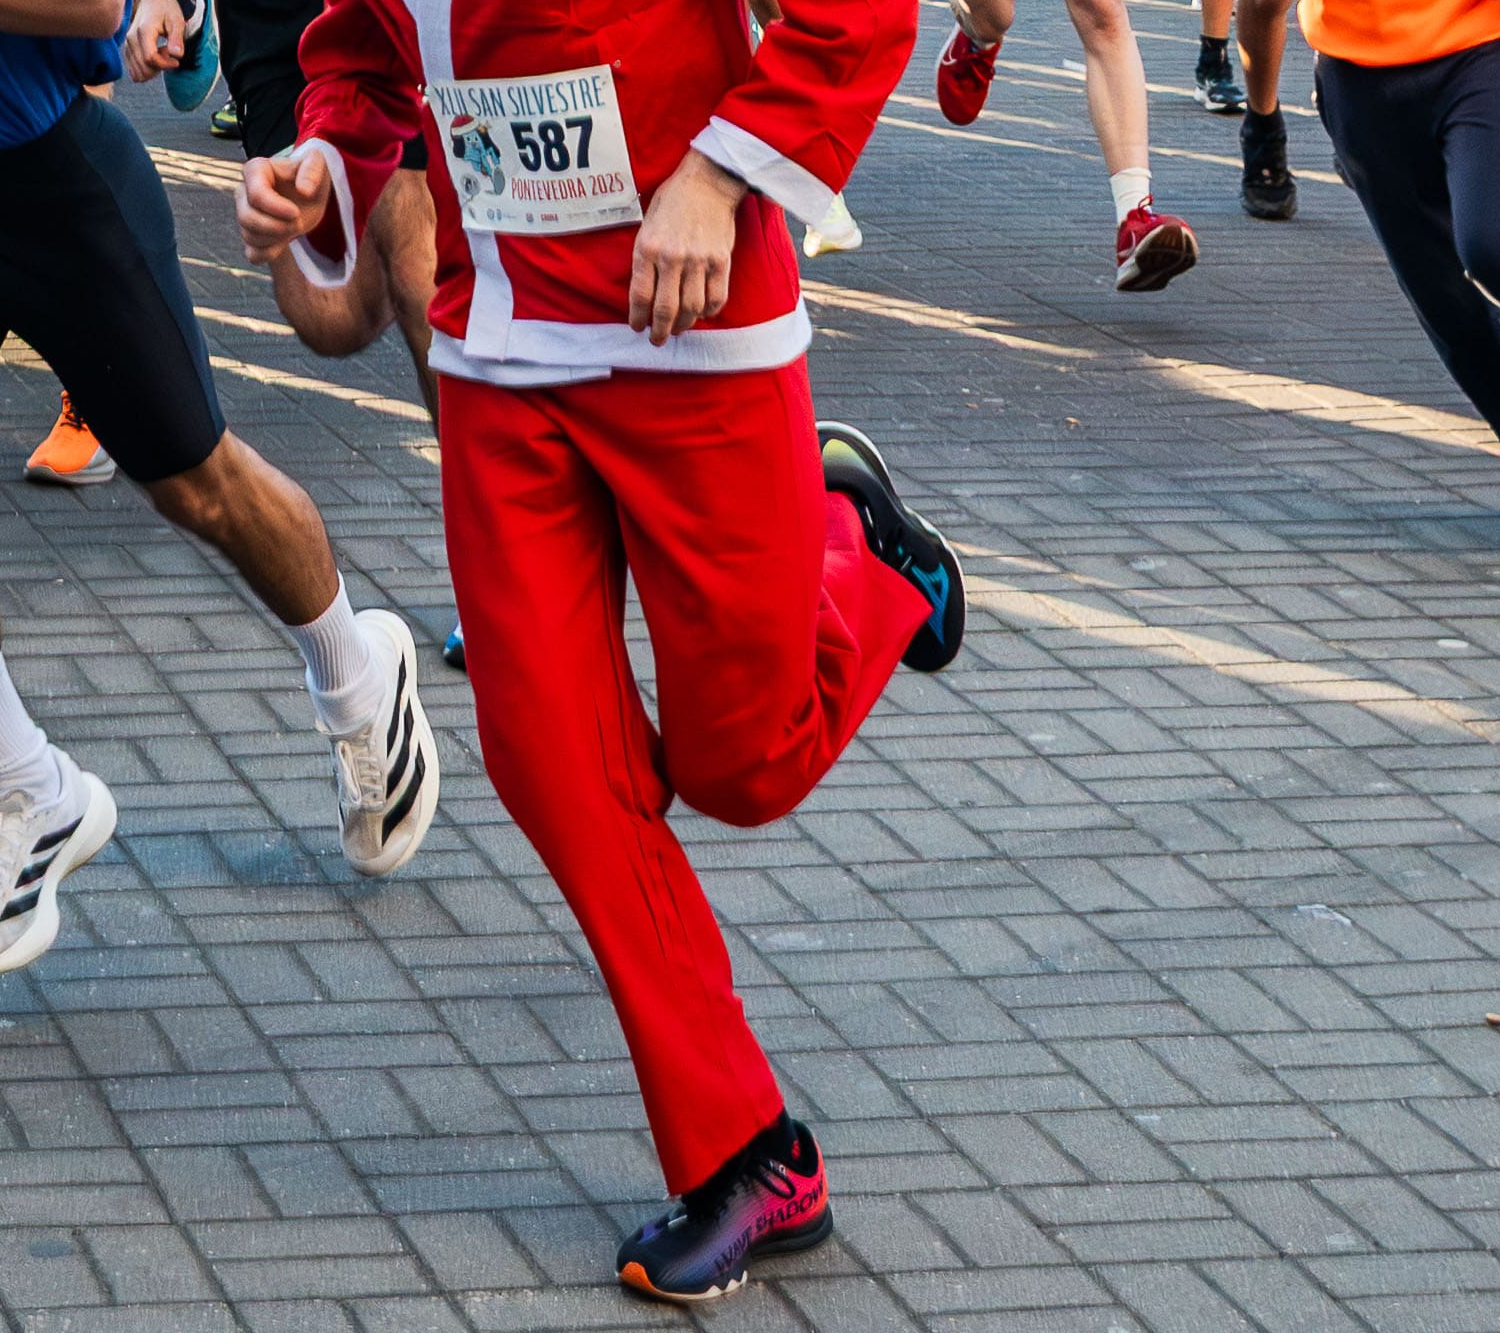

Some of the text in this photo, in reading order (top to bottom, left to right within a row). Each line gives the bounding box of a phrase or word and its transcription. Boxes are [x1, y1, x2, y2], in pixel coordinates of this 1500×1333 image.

[468, 86, 506, 118] SAN
[507, 74, 606, 118] SILVESTRE
[509, 114, 594, 172] 587
[511, 172, 625, 202] PONTEVEDRA 2025
[754, 1174, 825, 1233] SHADOW
